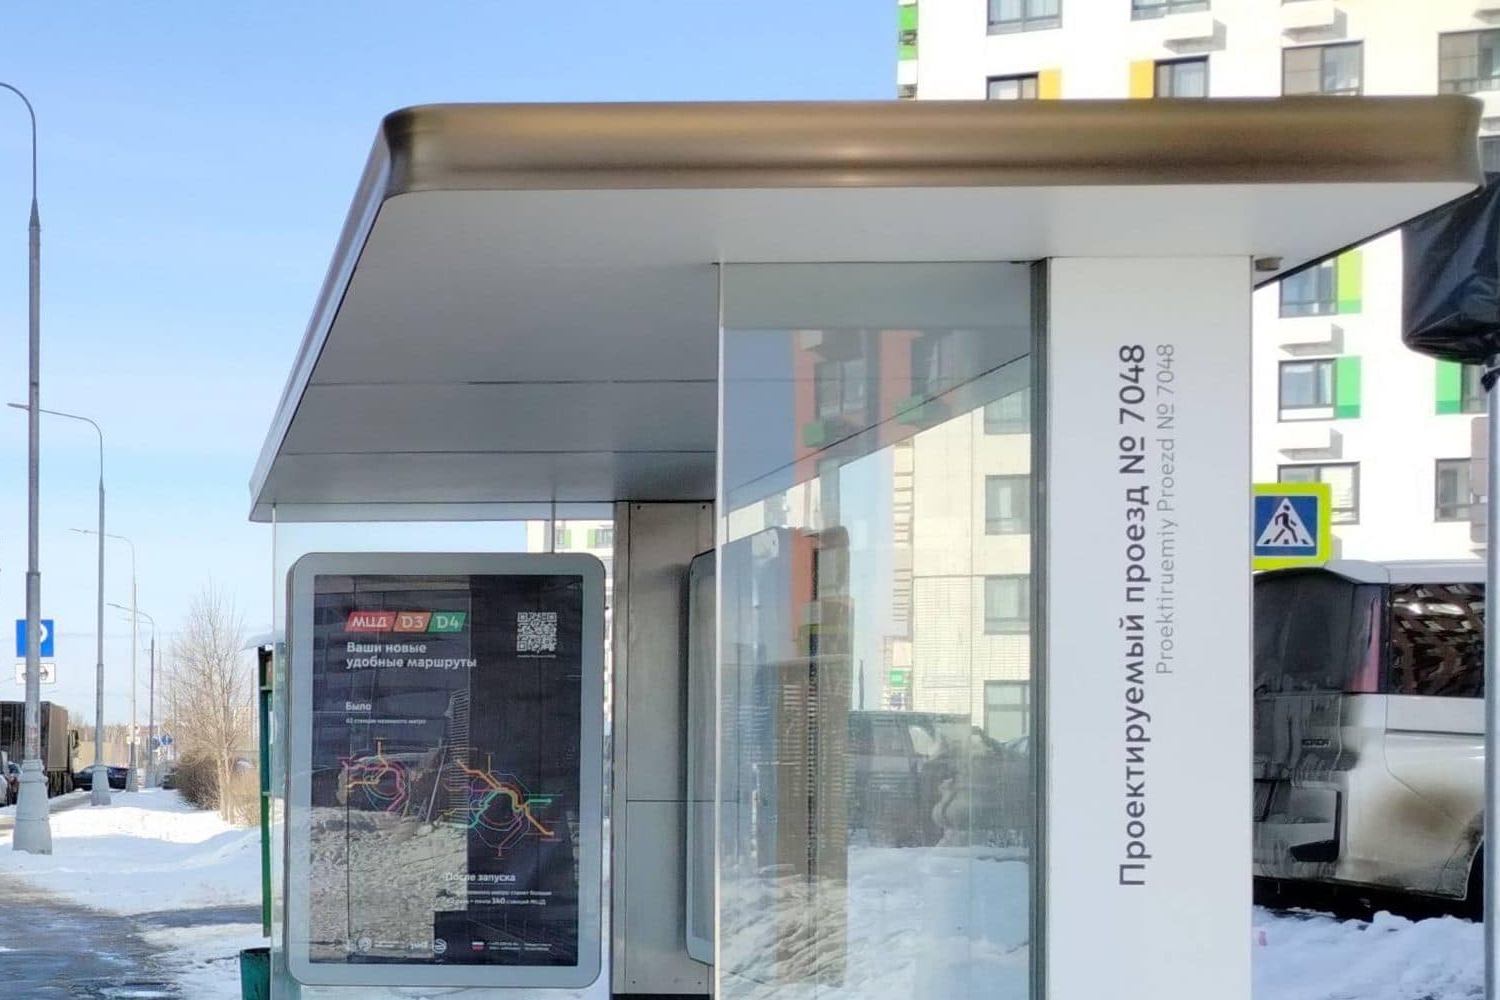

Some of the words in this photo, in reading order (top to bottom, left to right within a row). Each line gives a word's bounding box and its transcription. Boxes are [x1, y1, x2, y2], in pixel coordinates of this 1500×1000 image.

[1118, 344, 1145, 425] 7048
[1155, 343, 1175, 396] 7048
[1155, 402, 1175, 430] №
[1118, 435, 1145, 475] №
[1155, 437, 1175, 512] Proezd
[1126, 485, 1151, 602] проезд
[1155, 517, 1179, 675] Proektiruemiy
[351, 615, 389, 628] МЦД
[401, 615, 424, 628] D3
[435, 615, 460, 629] D4
[345, 656, 404, 669] удобные
[406, 657, 477, 669] маршруты
[346, 641, 382, 654] Ваши
[385, 643, 427, 654] новые
[345, 701, 372, 711] Было
[1119, 614, 1151, 886] Проектируемый
[477, 873, 516, 884] запуска
